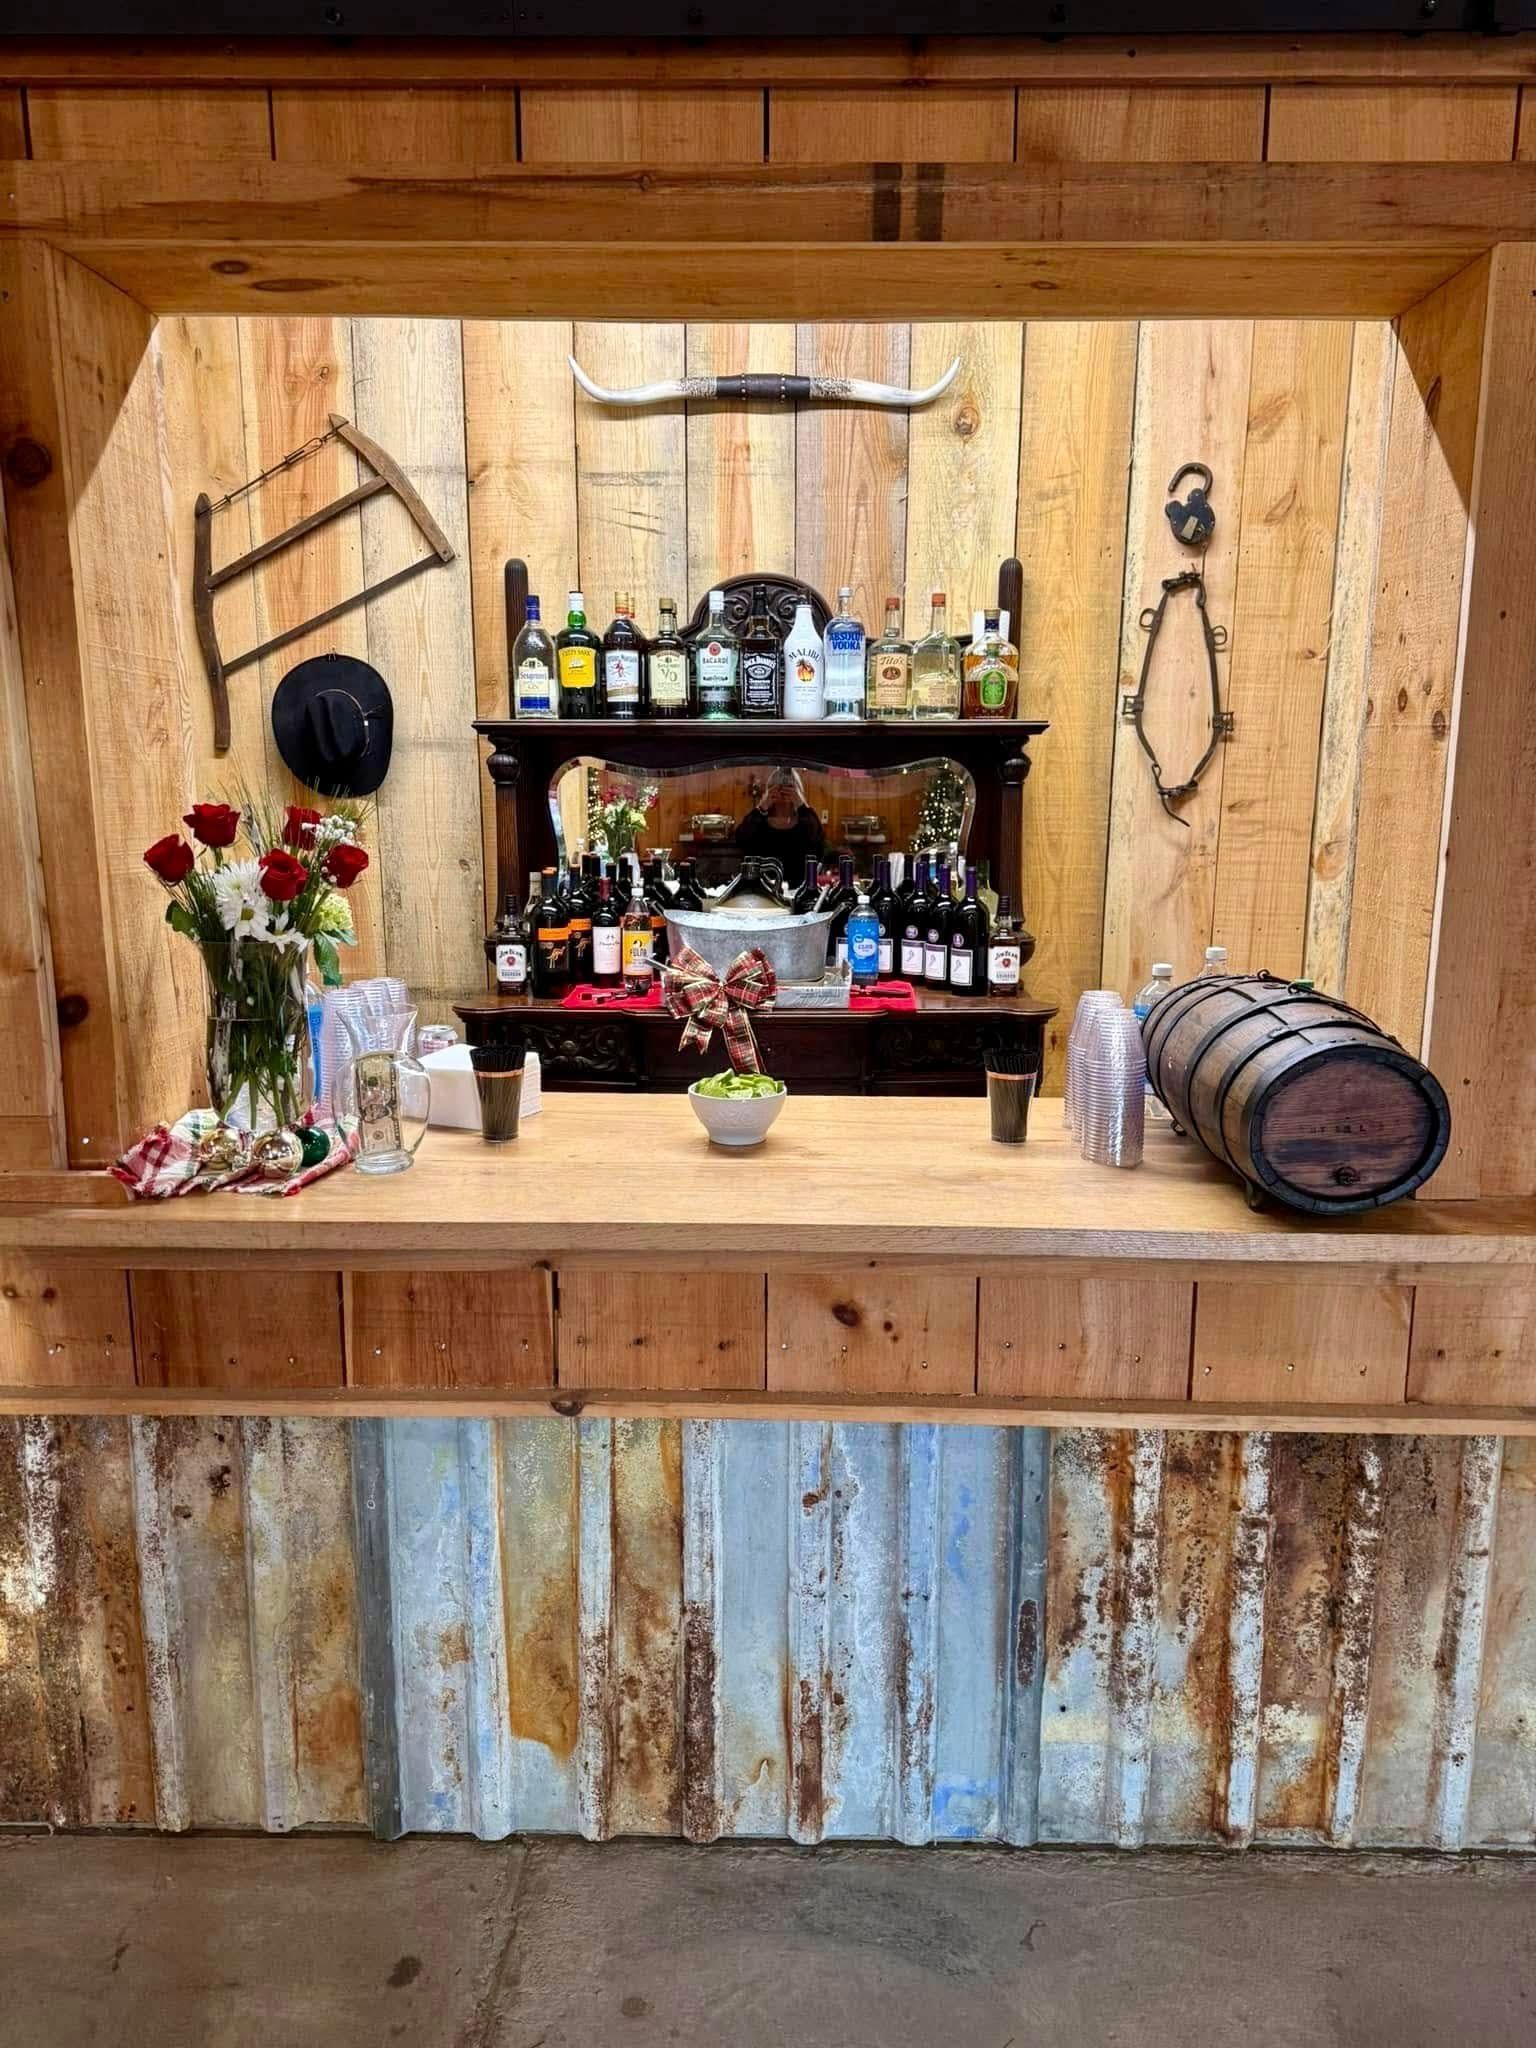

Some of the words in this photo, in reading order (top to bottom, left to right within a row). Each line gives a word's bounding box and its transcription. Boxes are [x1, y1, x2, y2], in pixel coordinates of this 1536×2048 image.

[829, 631, 863, 641] ABSOLUT
[832, 641, 861, 650] VODKA
[702, 656, 728, 664] BACARDI
[788, 648, 821, 663] MALIBU
[880, 655, 904, 665] Tito's
